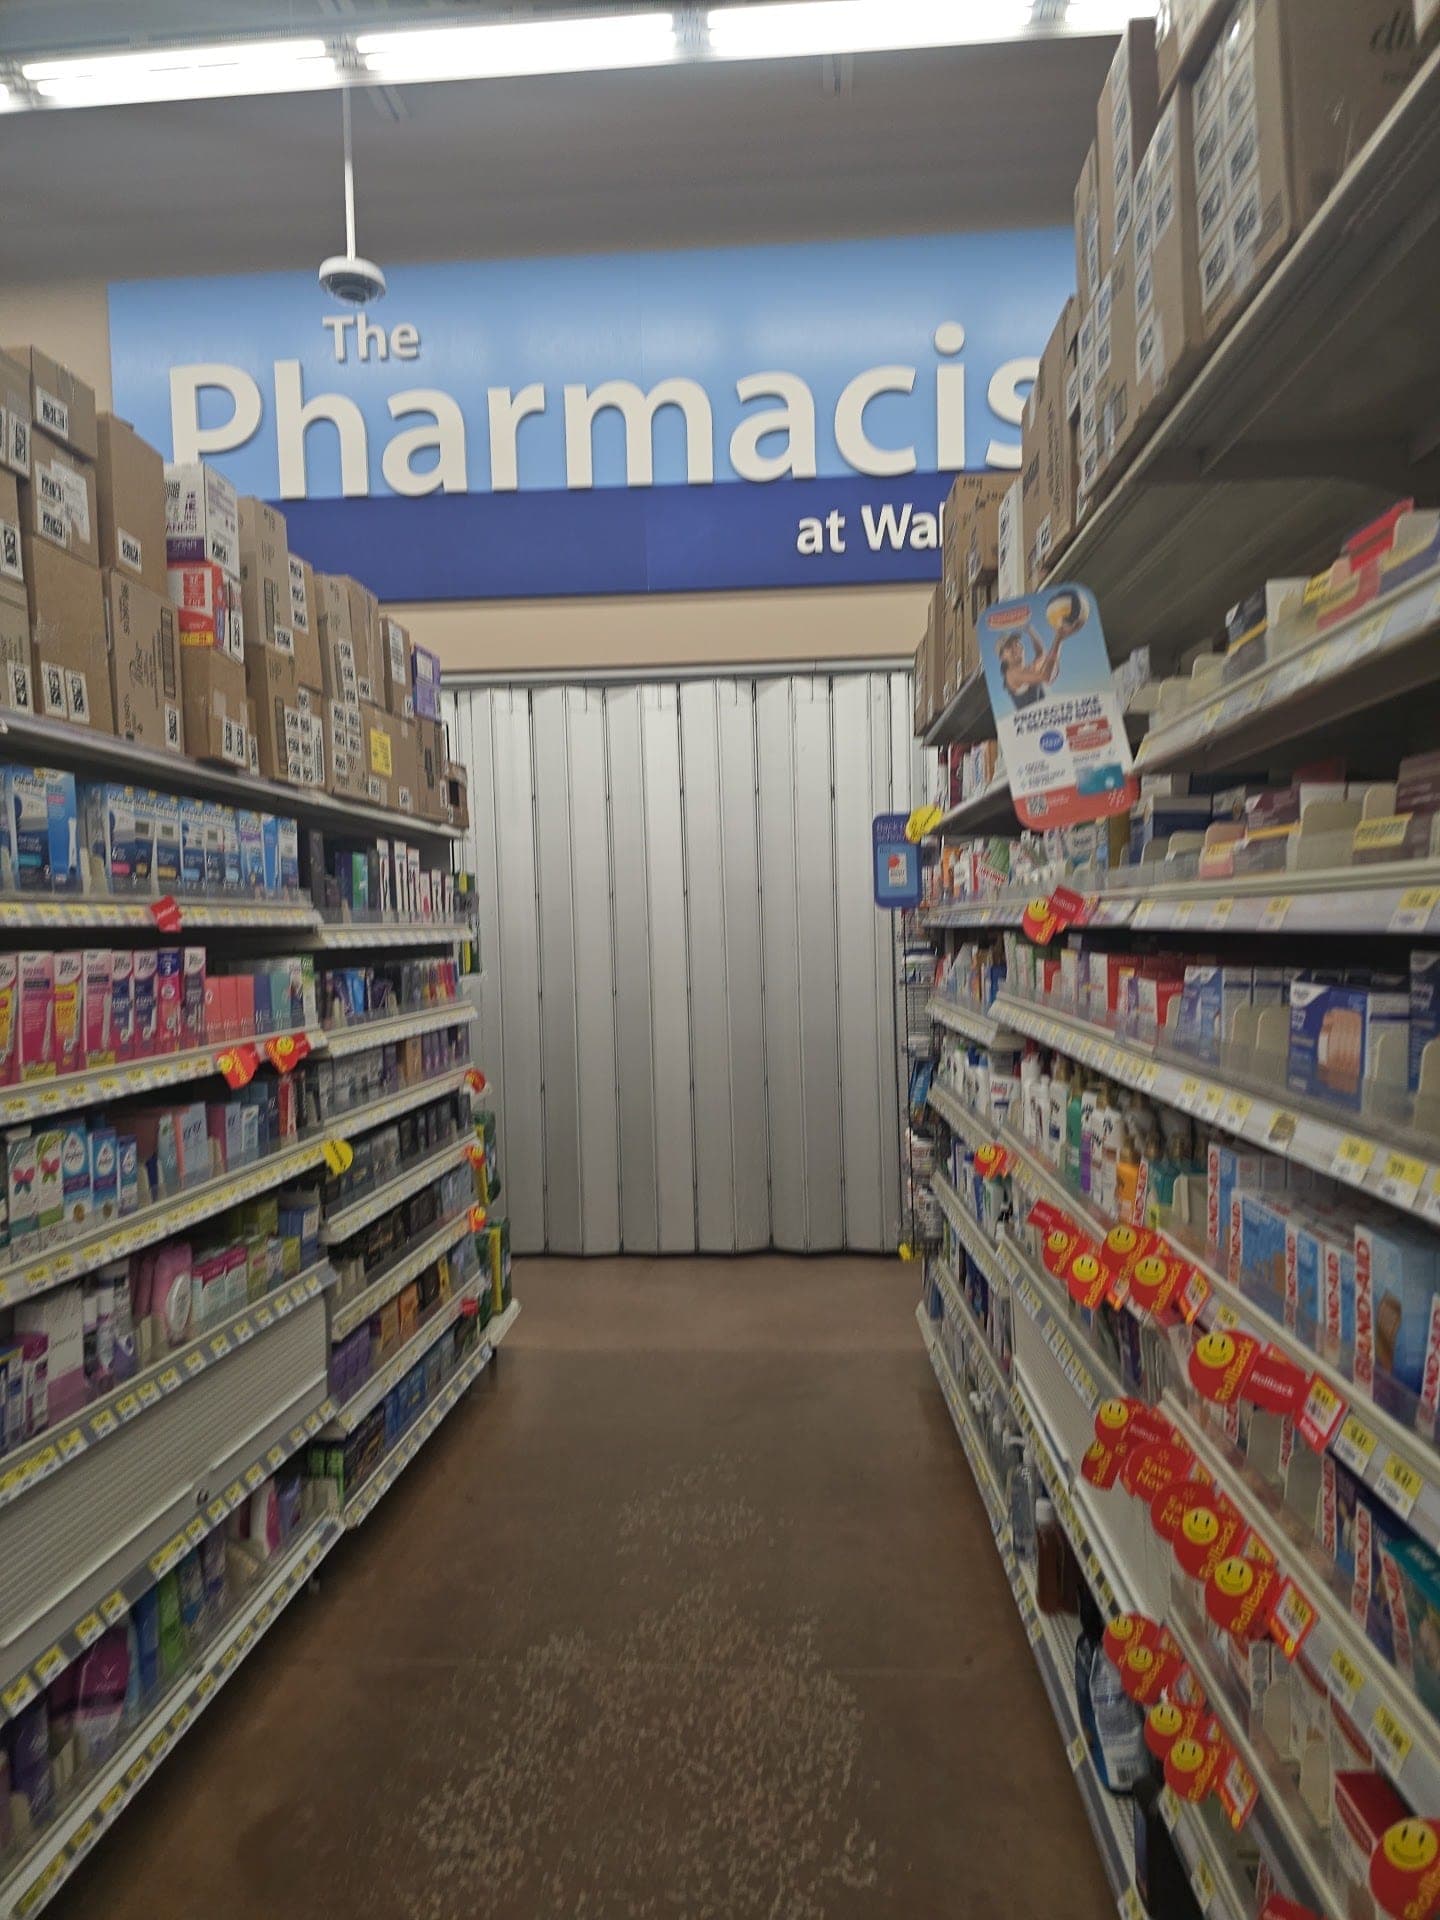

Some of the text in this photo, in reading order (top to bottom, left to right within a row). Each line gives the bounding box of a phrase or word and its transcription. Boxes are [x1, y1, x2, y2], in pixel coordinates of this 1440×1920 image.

[322, 313, 420, 362] The
[797, 509, 846, 556] at
[1215, 1339, 1255, 1400] Rollback
[1250, 1370, 1296, 1397] Rollback
[1230, 1569, 1273, 1634] Rollback
